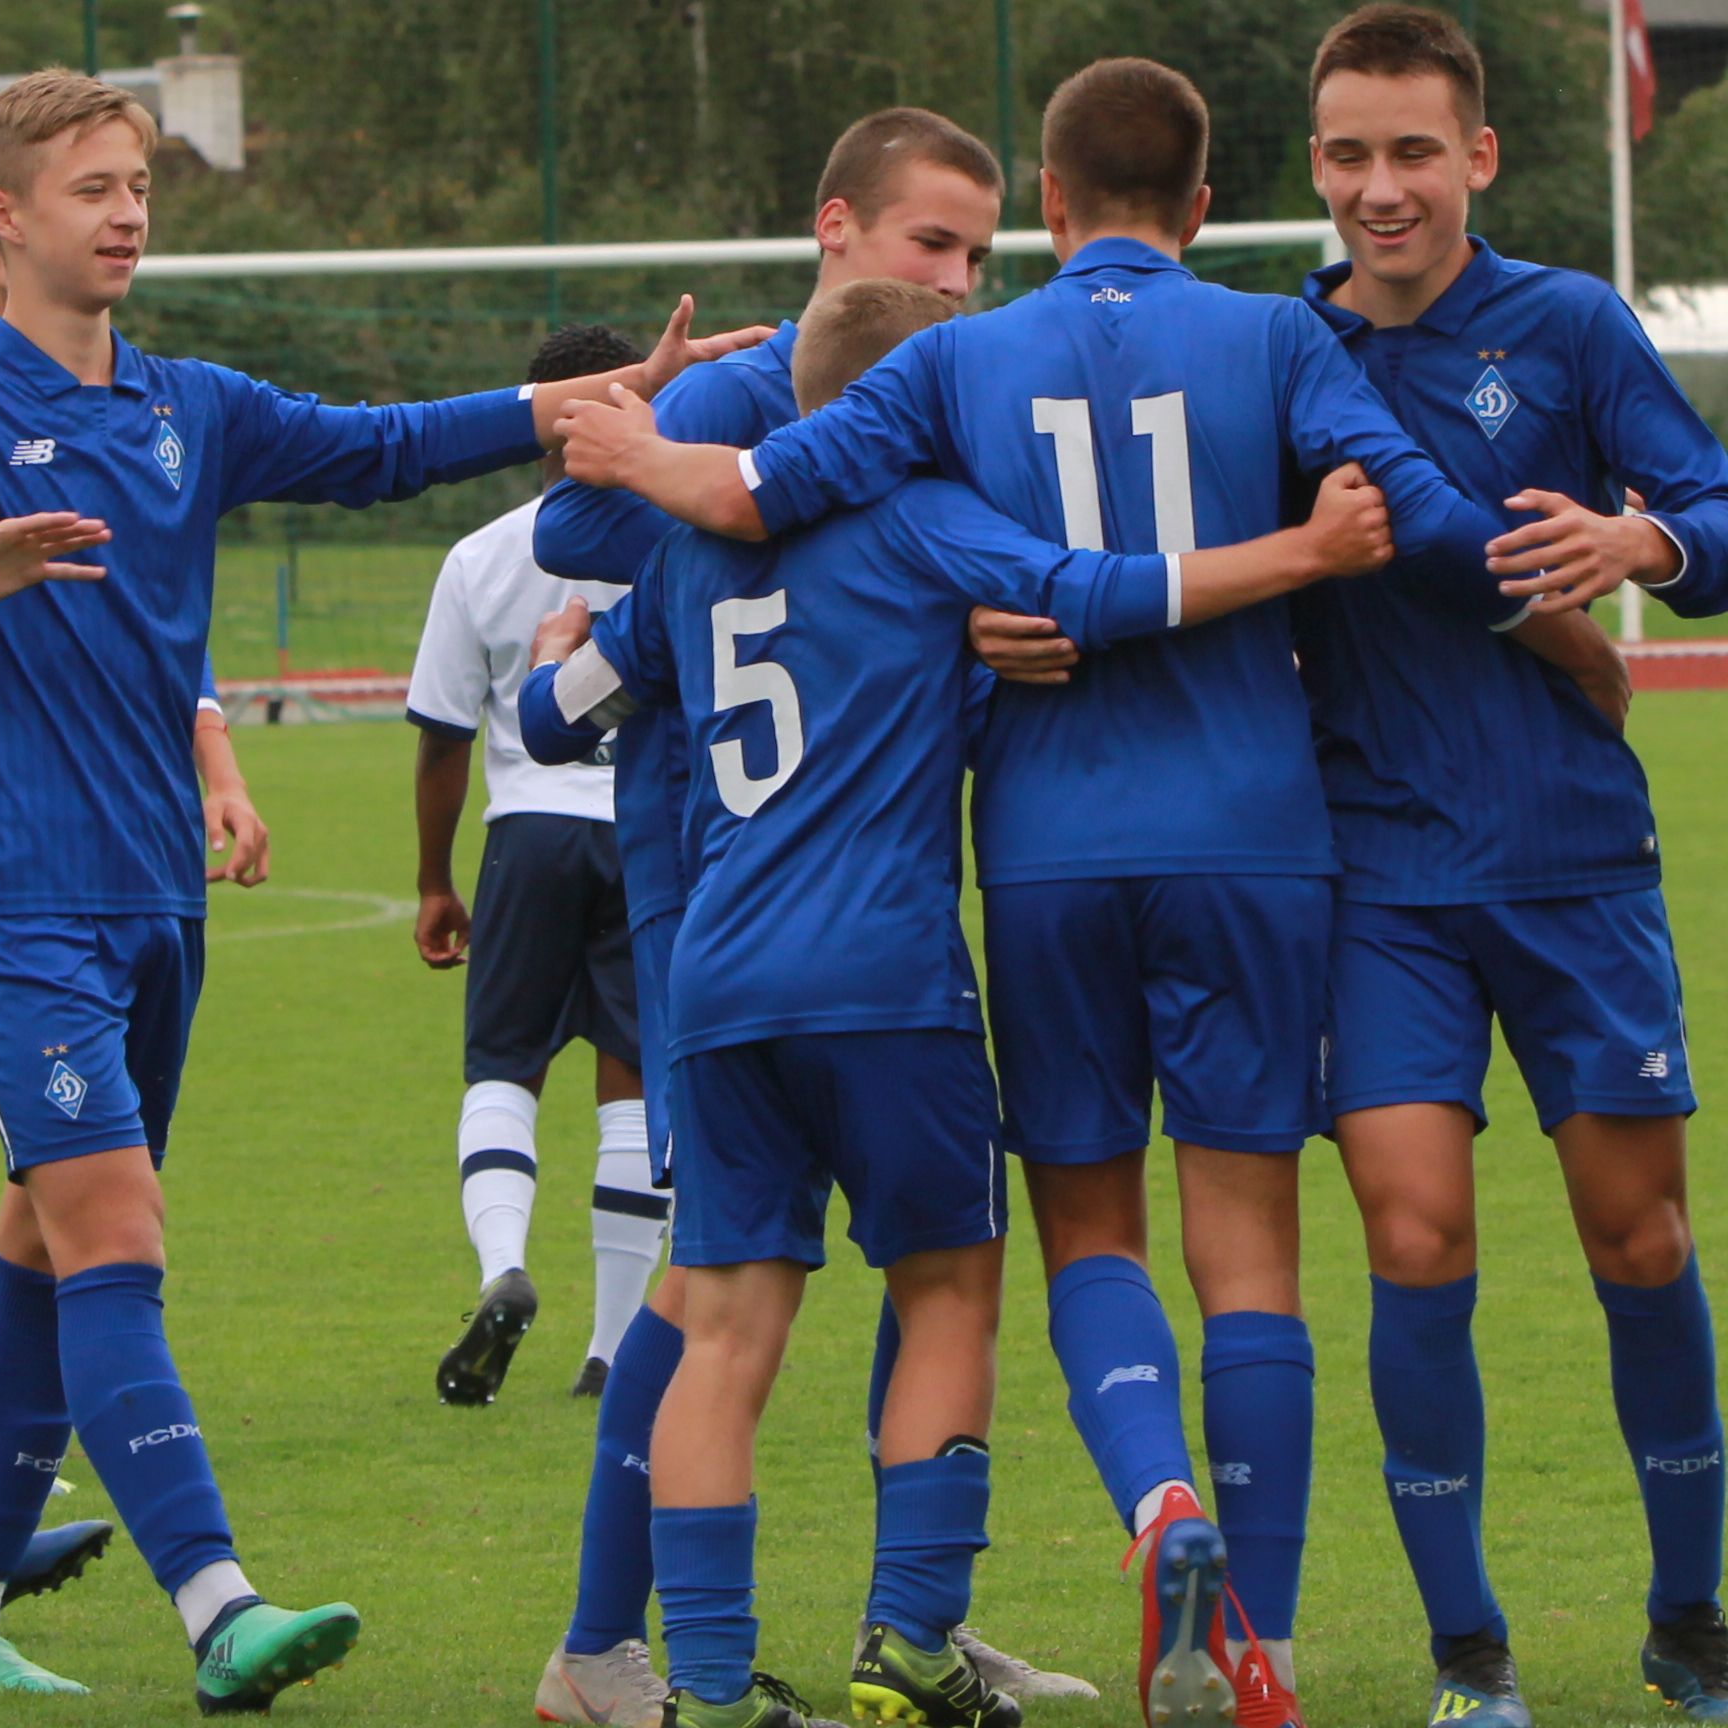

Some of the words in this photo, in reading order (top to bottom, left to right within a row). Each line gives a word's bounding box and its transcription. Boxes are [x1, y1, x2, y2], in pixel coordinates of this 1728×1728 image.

[1031, 390, 1196, 556] 11
[708, 588, 805, 818] 5
[621, 1453, 651, 1475] FC
